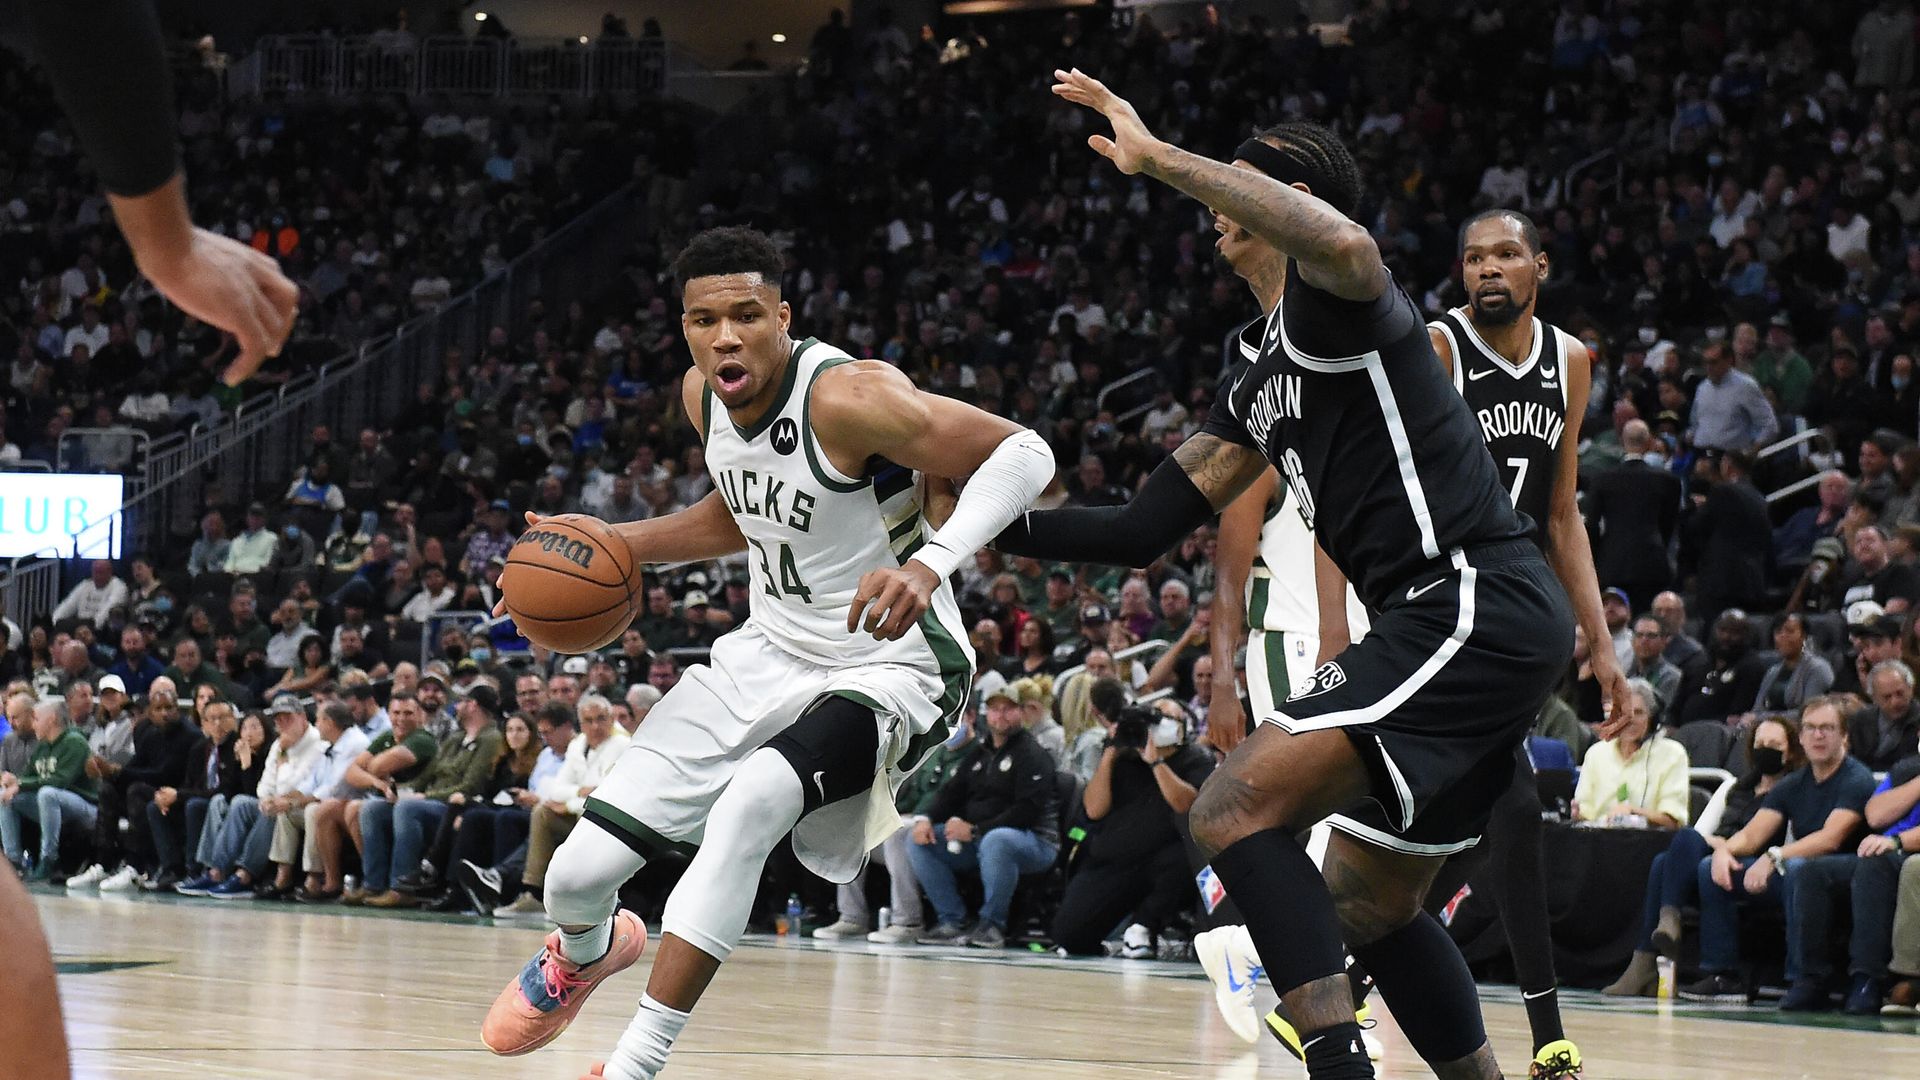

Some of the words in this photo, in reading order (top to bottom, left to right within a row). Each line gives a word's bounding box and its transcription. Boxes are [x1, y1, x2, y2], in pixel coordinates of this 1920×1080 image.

[1246, 373, 1302, 461] ROOKLYN
[1477, 400, 1565, 450] ROOKLYN
[1507, 457, 1529, 509] 7
[516, 530, 594, 568] Wilson
[747, 536, 812, 604] 34
